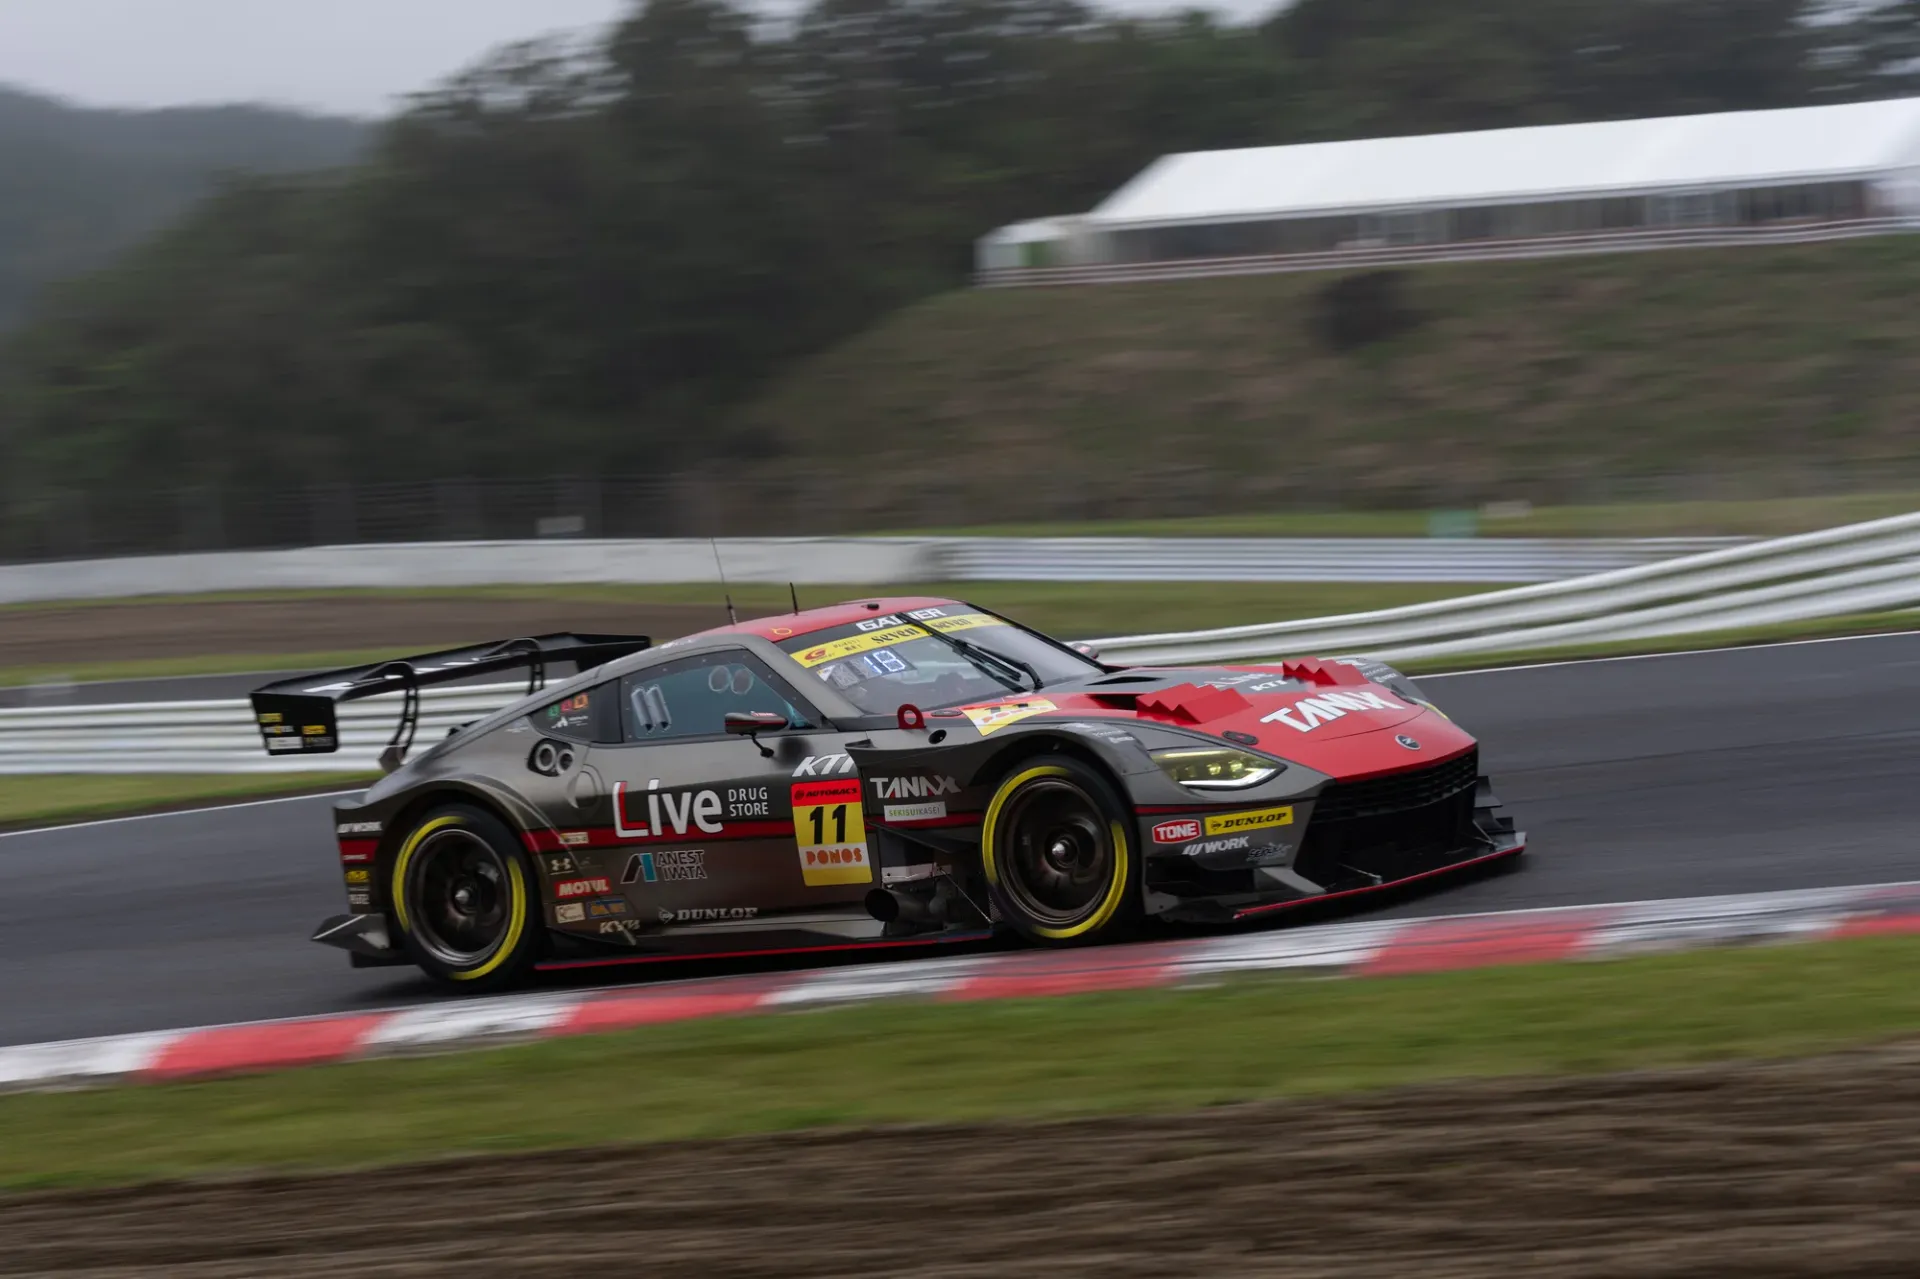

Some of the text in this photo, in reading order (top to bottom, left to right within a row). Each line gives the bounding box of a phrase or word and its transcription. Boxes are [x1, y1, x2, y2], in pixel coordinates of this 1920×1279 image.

[871, 624, 920, 644] seven
[728, 787, 768, 802] DRUG
[805, 787, 858, 797] AUTOBACS
[869, 775, 961, 799] TANAX
[612, 778, 724, 838] Live
[729, 802, 769, 817] STORE
[809, 804, 847, 845] 11
[1223, 812, 1287, 829] DUNLOP
[1156, 822, 1198, 841] TONE
[1203, 836, 1249, 854] WORK
[656, 850, 705, 868] ANEST
[805, 847, 863, 866] PONOS
[663, 865, 708, 881] IWATA
[559, 879, 609, 897] MOTUL
[676, 907, 758, 920] DUNLOP
